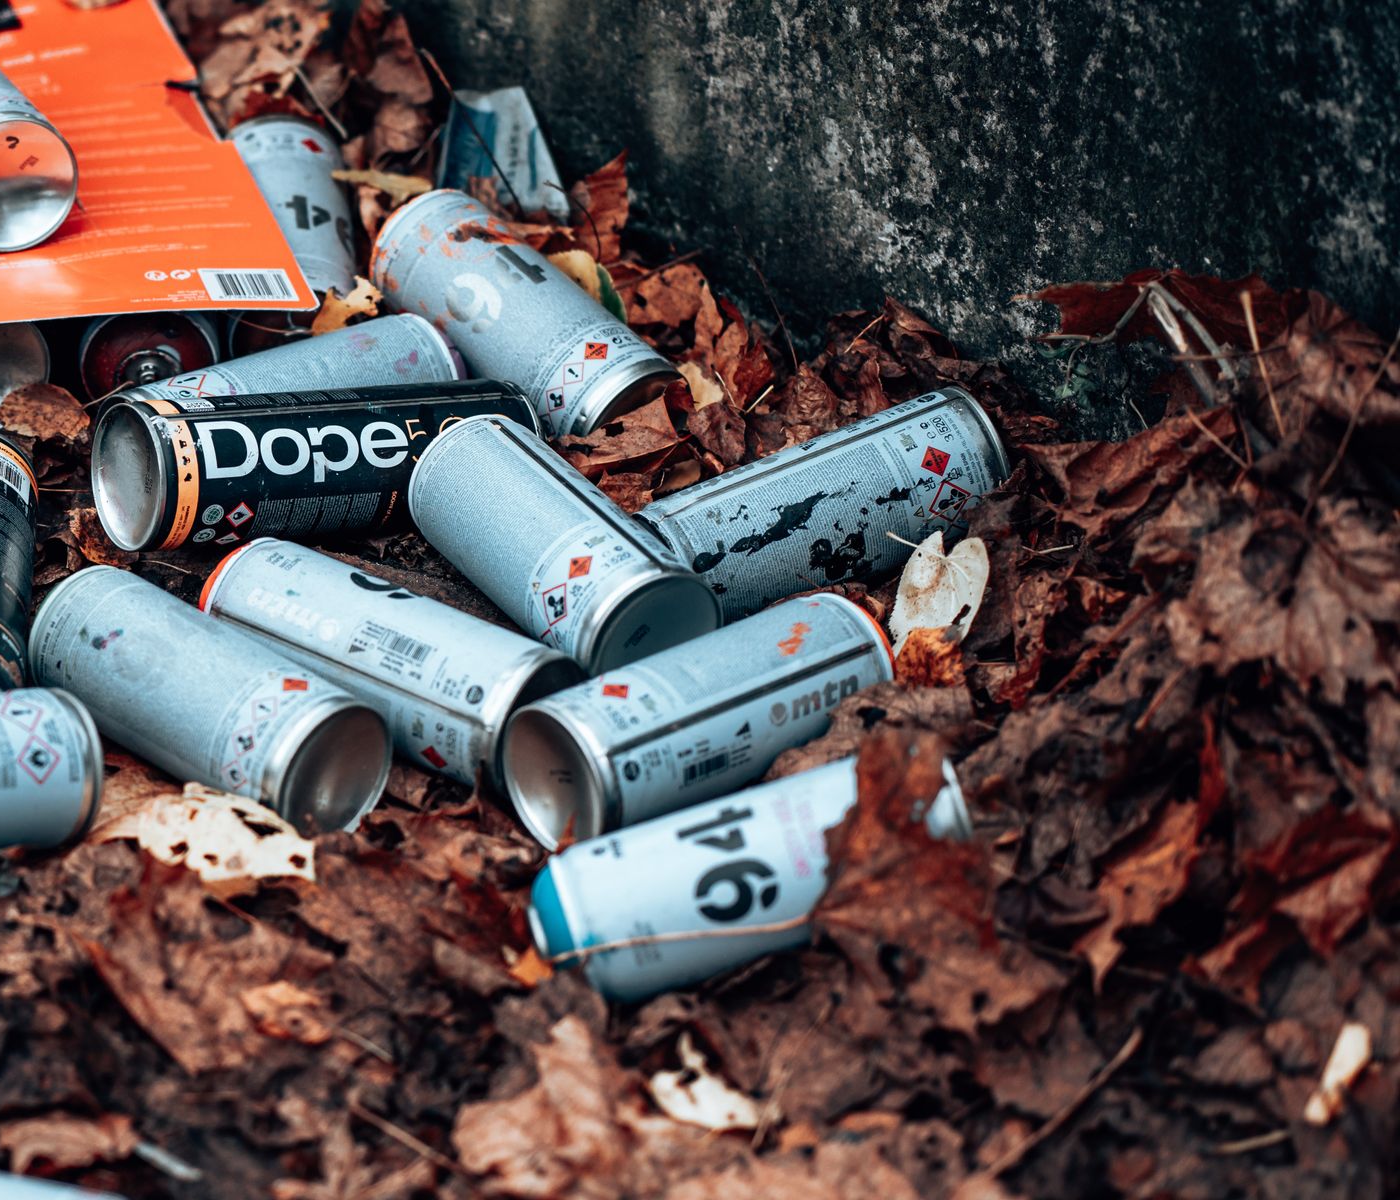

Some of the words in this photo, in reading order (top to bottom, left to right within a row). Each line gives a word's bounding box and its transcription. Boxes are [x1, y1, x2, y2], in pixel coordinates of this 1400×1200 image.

[195, 420, 409, 483] Dope
[932, 416, 949, 434] 520
[792, 674, 859, 720] mtn
[677, 806, 780, 923] 94
